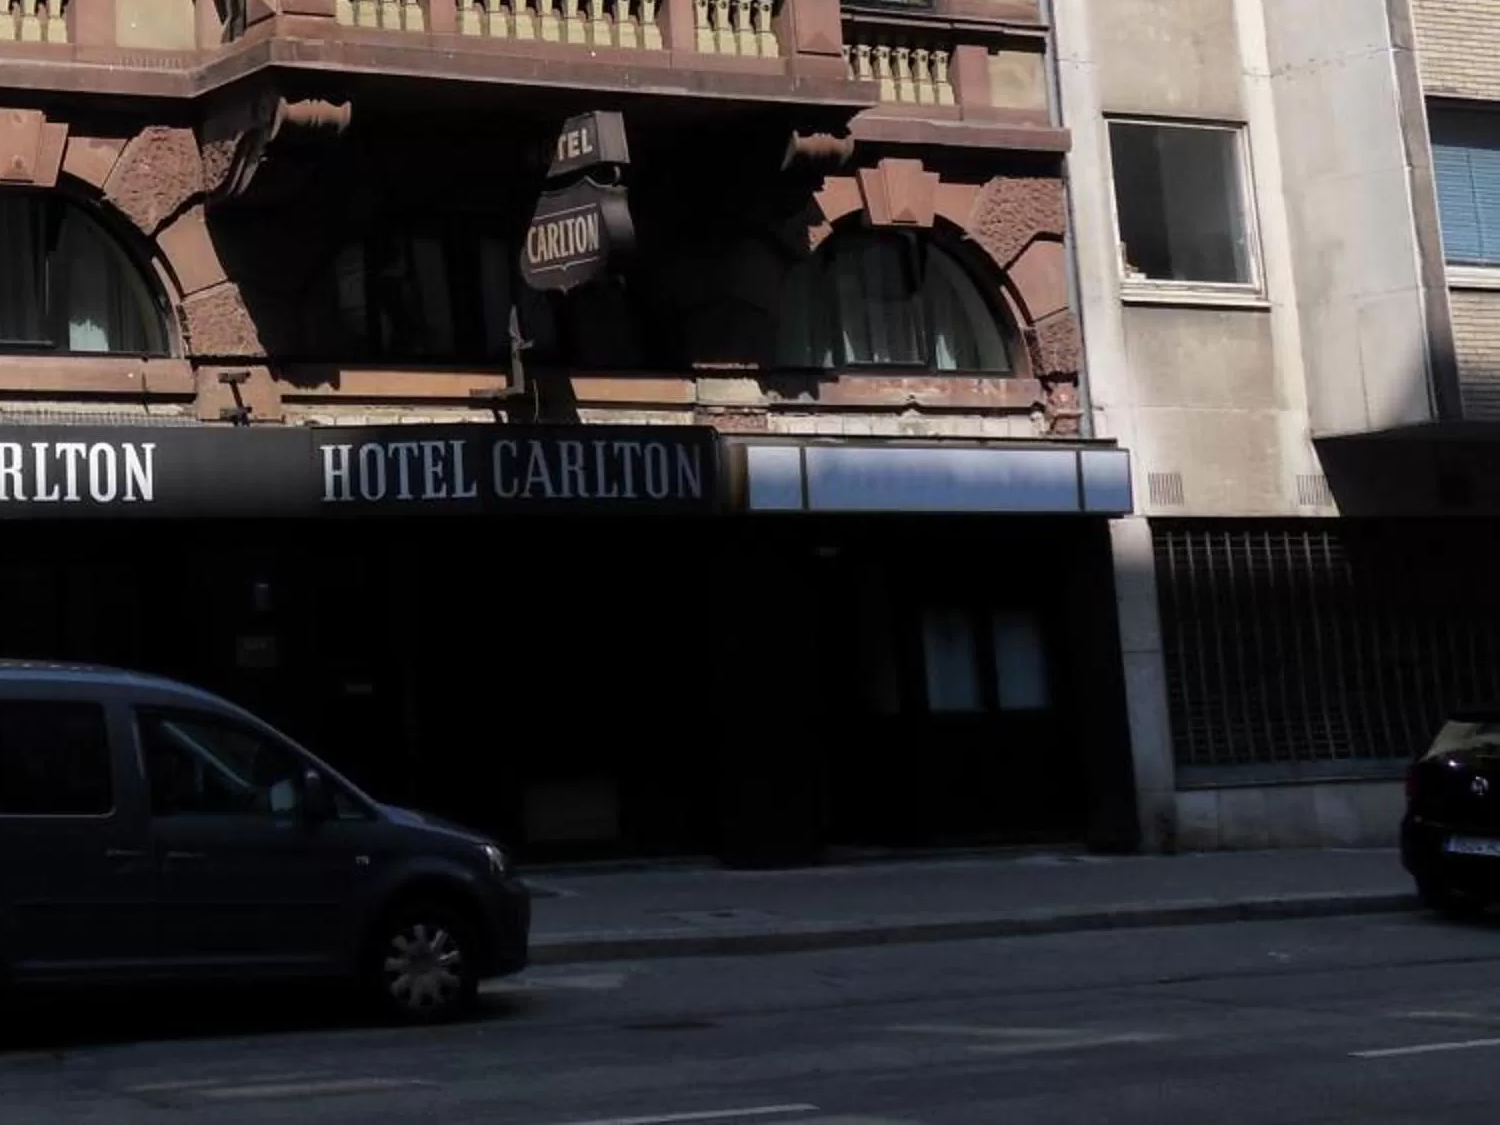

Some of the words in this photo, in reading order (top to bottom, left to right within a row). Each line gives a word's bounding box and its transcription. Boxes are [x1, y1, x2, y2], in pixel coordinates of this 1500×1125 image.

[556, 127, 594, 162] TEL
[526, 211, 600, 264] CARLTON
[320, 440, 477, 502] HOTEL
[492, 438, 701, 500] CARLTON
